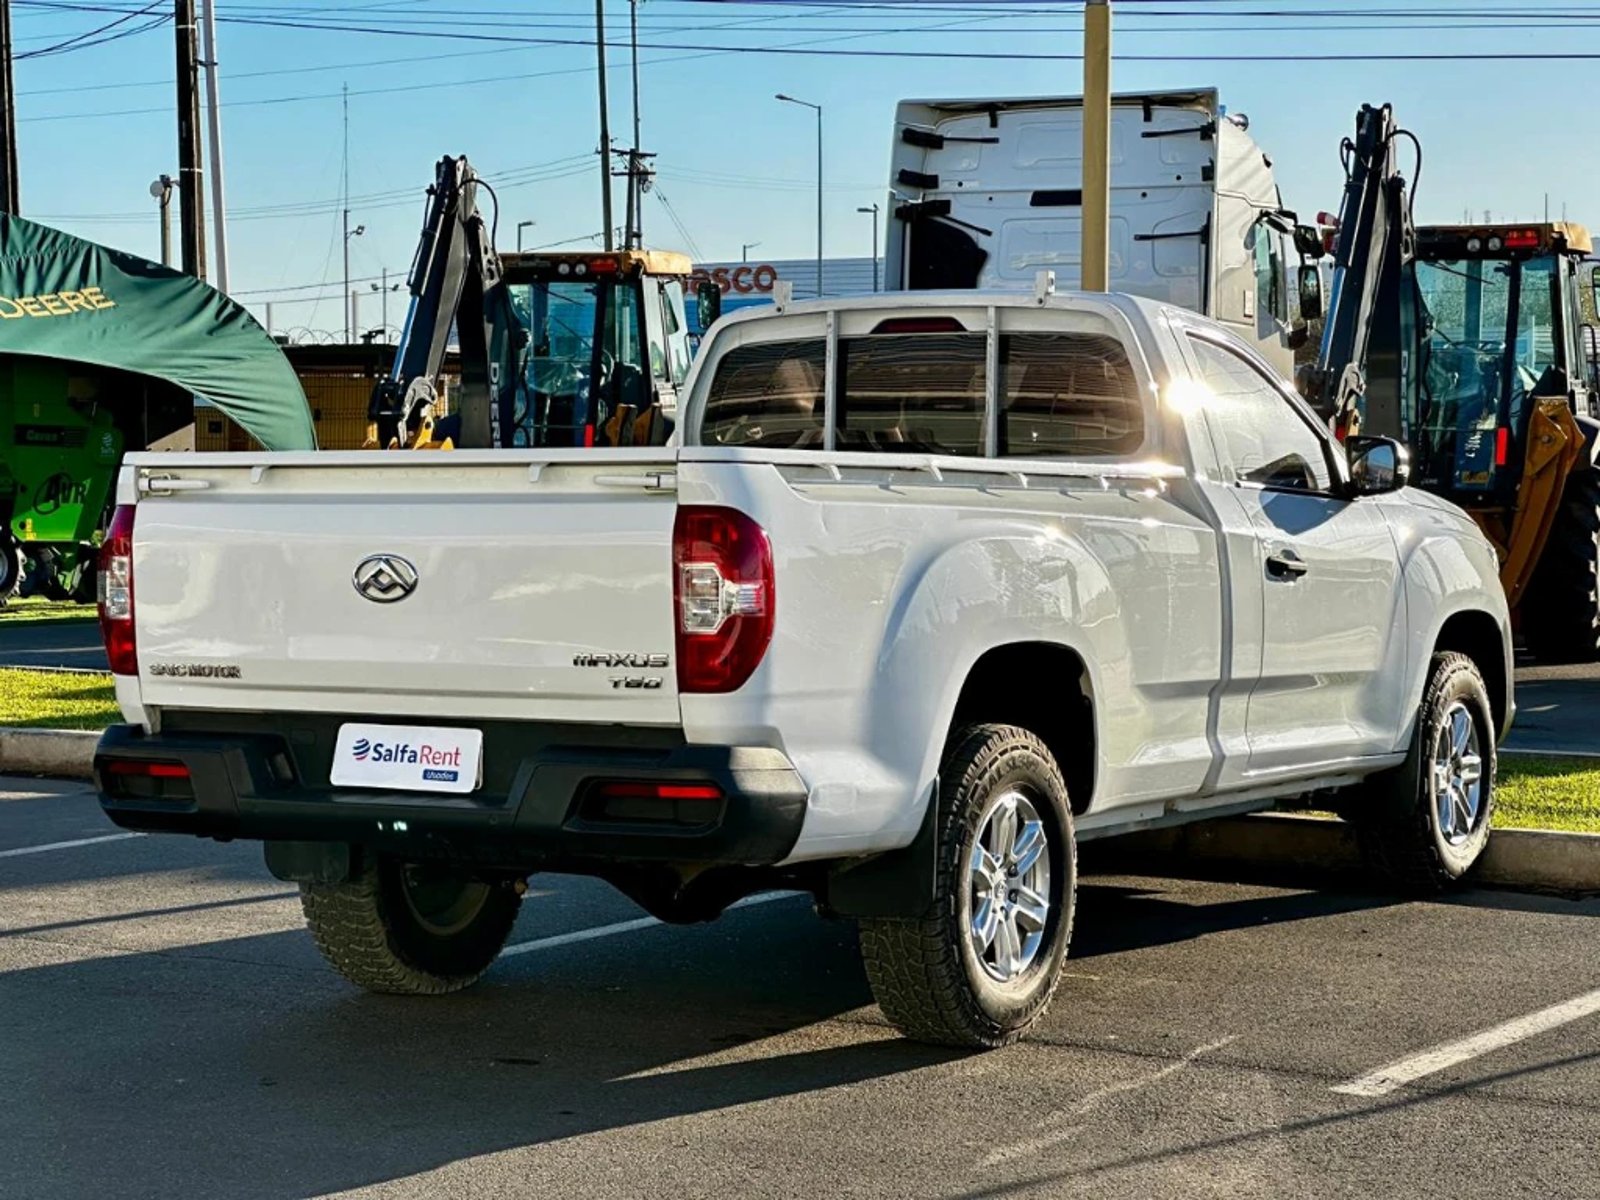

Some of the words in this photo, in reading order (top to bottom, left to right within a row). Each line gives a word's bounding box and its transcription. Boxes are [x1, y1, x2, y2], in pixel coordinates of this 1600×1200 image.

[0, 286, 116, 318] DEERE
[572, 652, 669, 668] MAXUS
[188, 664, 242, 679] MOTOR
